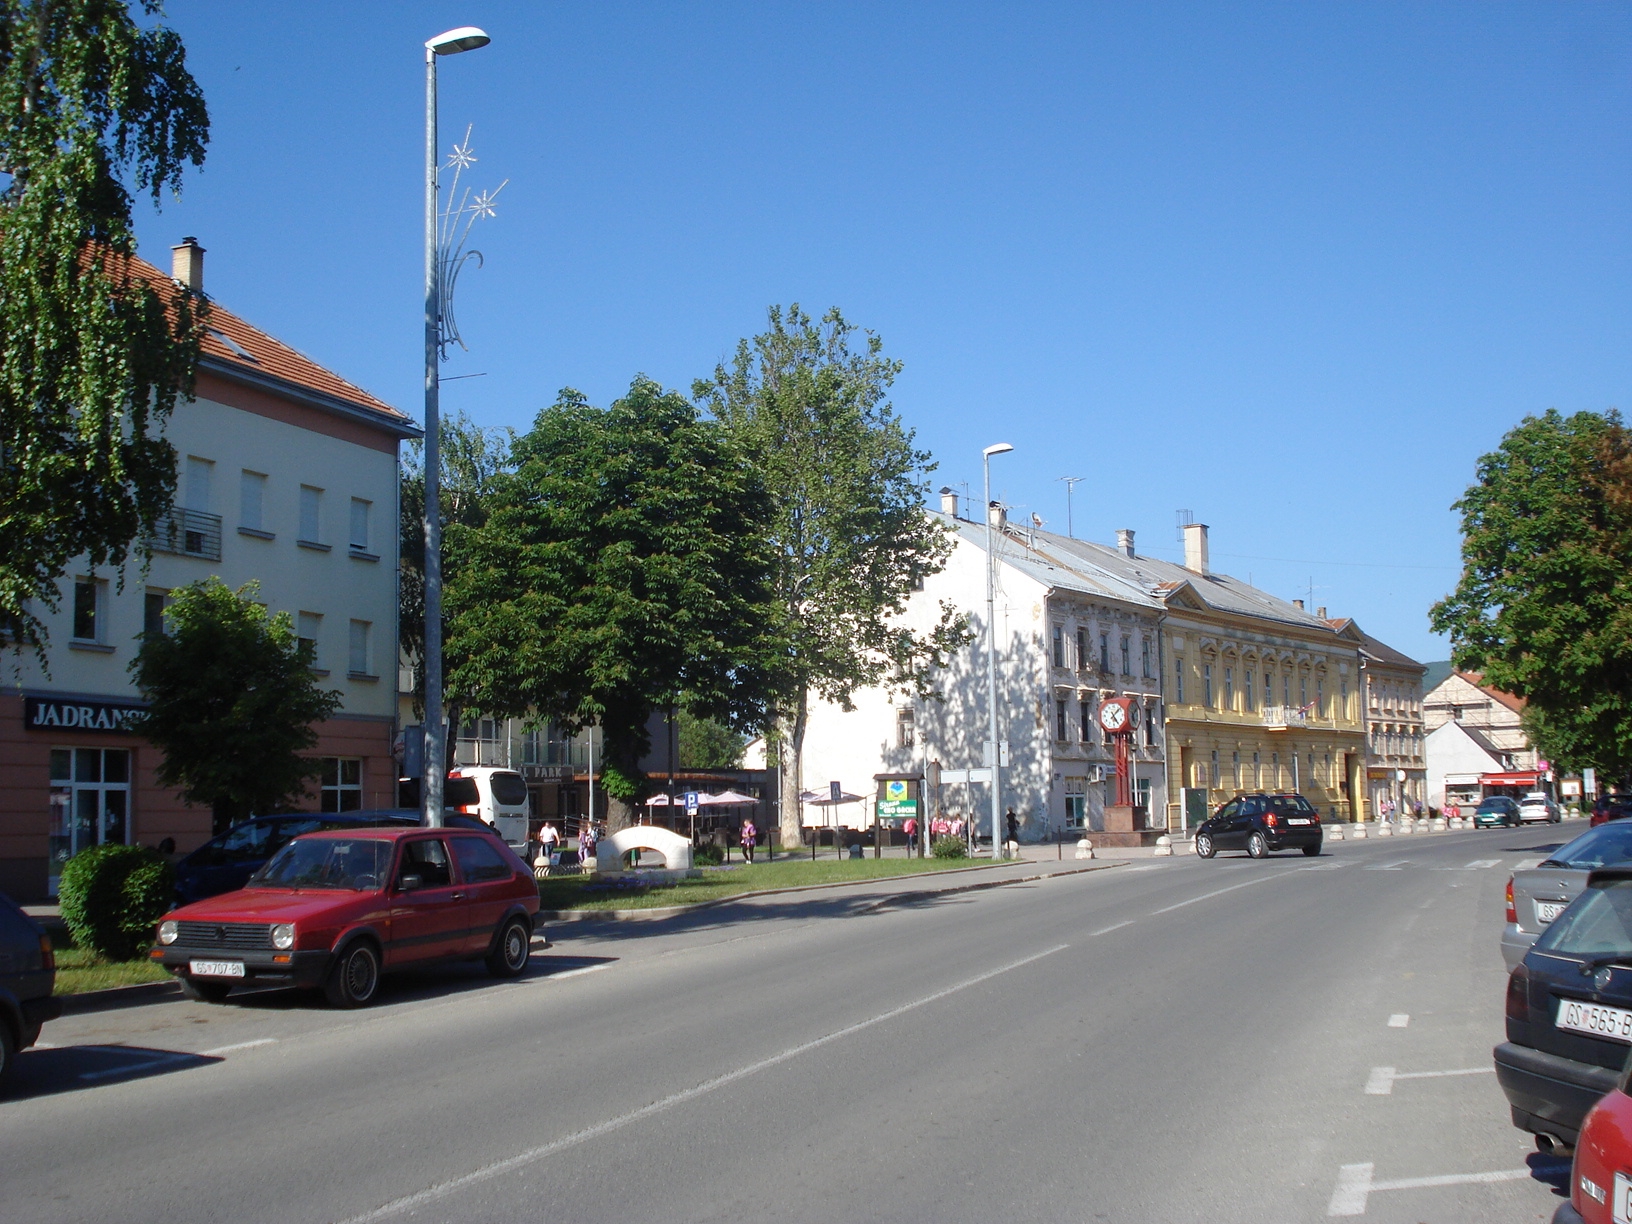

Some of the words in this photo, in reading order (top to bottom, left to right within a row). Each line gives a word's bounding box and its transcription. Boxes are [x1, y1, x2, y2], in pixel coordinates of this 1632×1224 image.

[535, 768, 561, 777] PARK
[688, 794, 696, 807] P
[1543, 902, 1555, 918] GS
[1566, 1003, 1582, 1026] GS
[1589, 1007, 1632, 1036] 565-B
